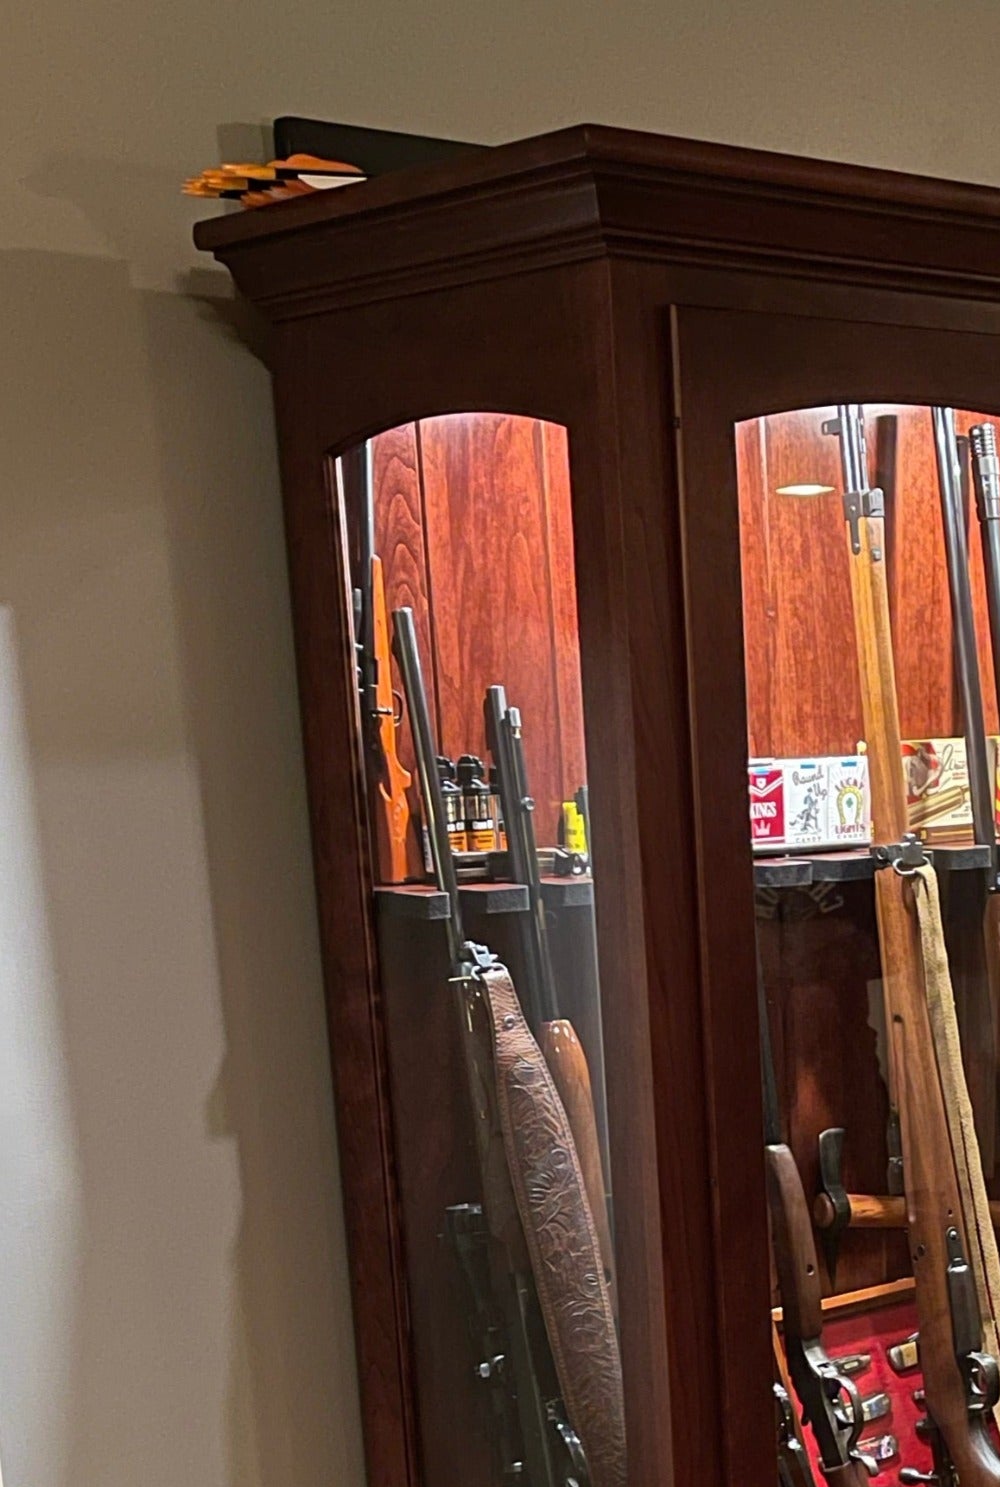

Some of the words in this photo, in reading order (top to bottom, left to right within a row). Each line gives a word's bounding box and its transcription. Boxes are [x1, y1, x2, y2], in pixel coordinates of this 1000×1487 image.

[792, 765, 824, 786] Round
[813, 783, 827, 800] Up
[834, 777, 864, 792] LUCKY
[835, 824, 865, 834] LIGHTS
